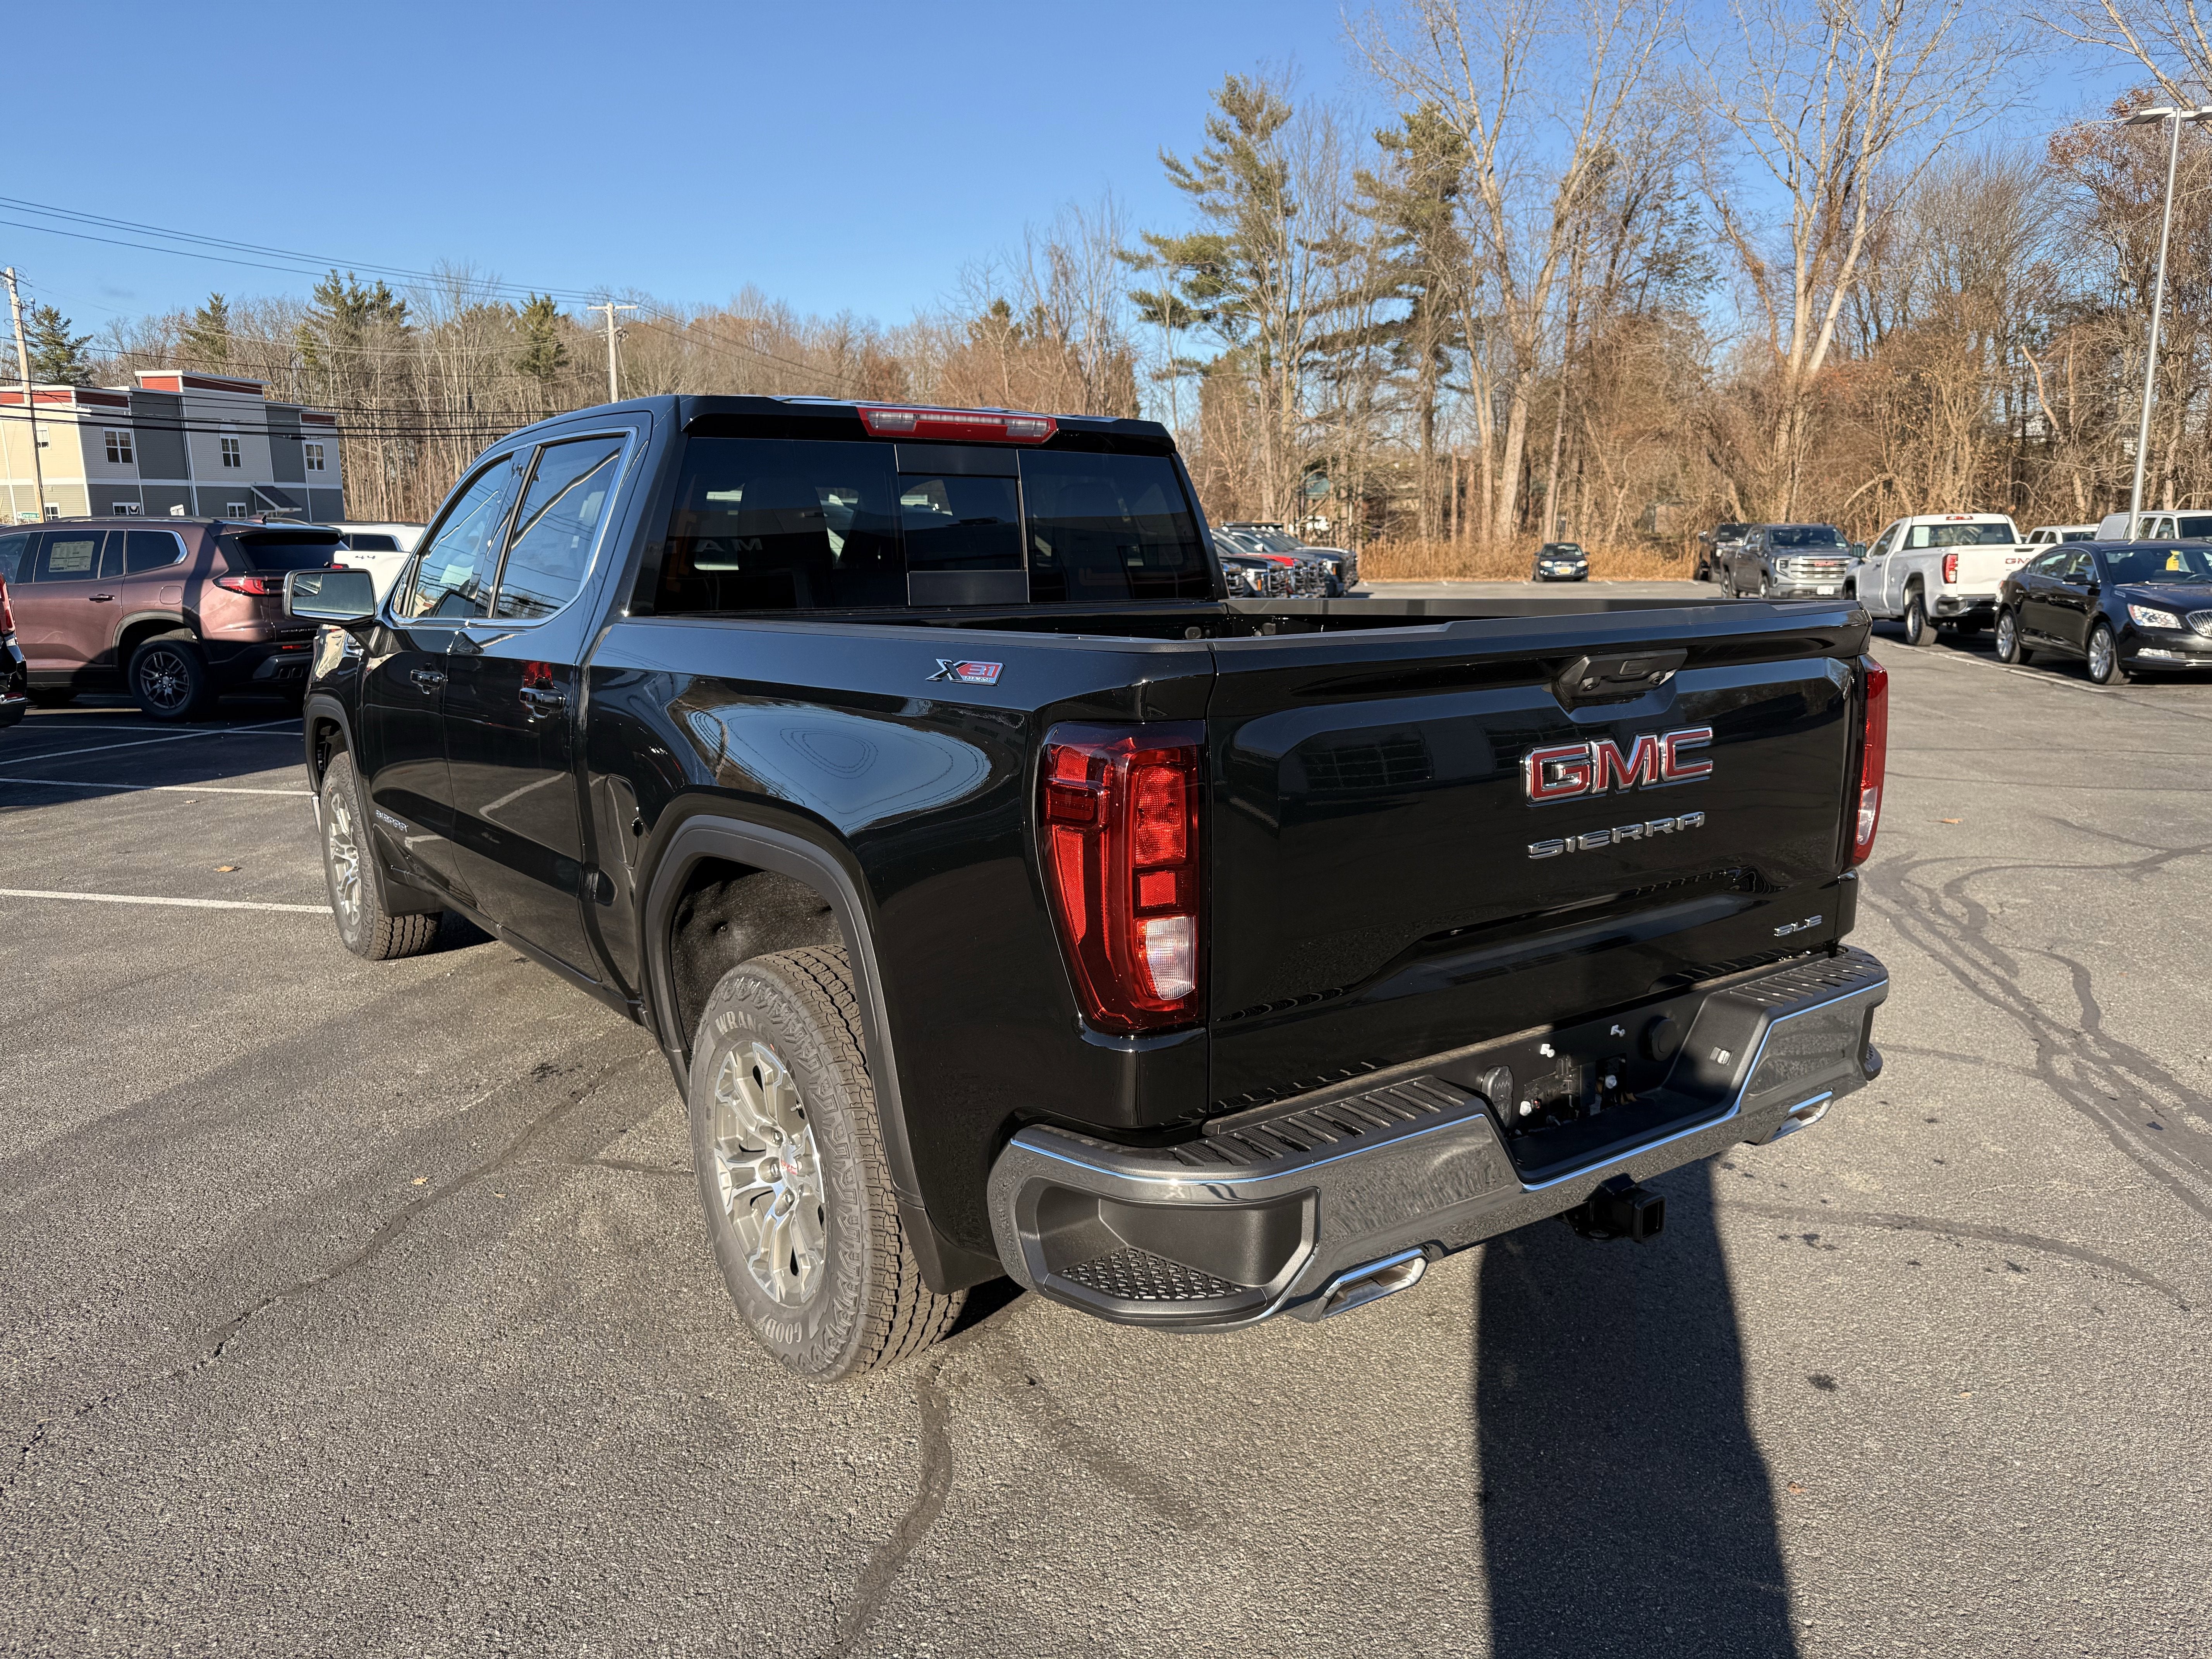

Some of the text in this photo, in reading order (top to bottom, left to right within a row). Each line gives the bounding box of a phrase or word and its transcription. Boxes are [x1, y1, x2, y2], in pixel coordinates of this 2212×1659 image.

[925, 658, 997, 682] X31
[1523, 726, 1713, 802] GMC
[1527, 811, 1705, 860] SIERRA
[1774, 915, 1822, 936] SLE
